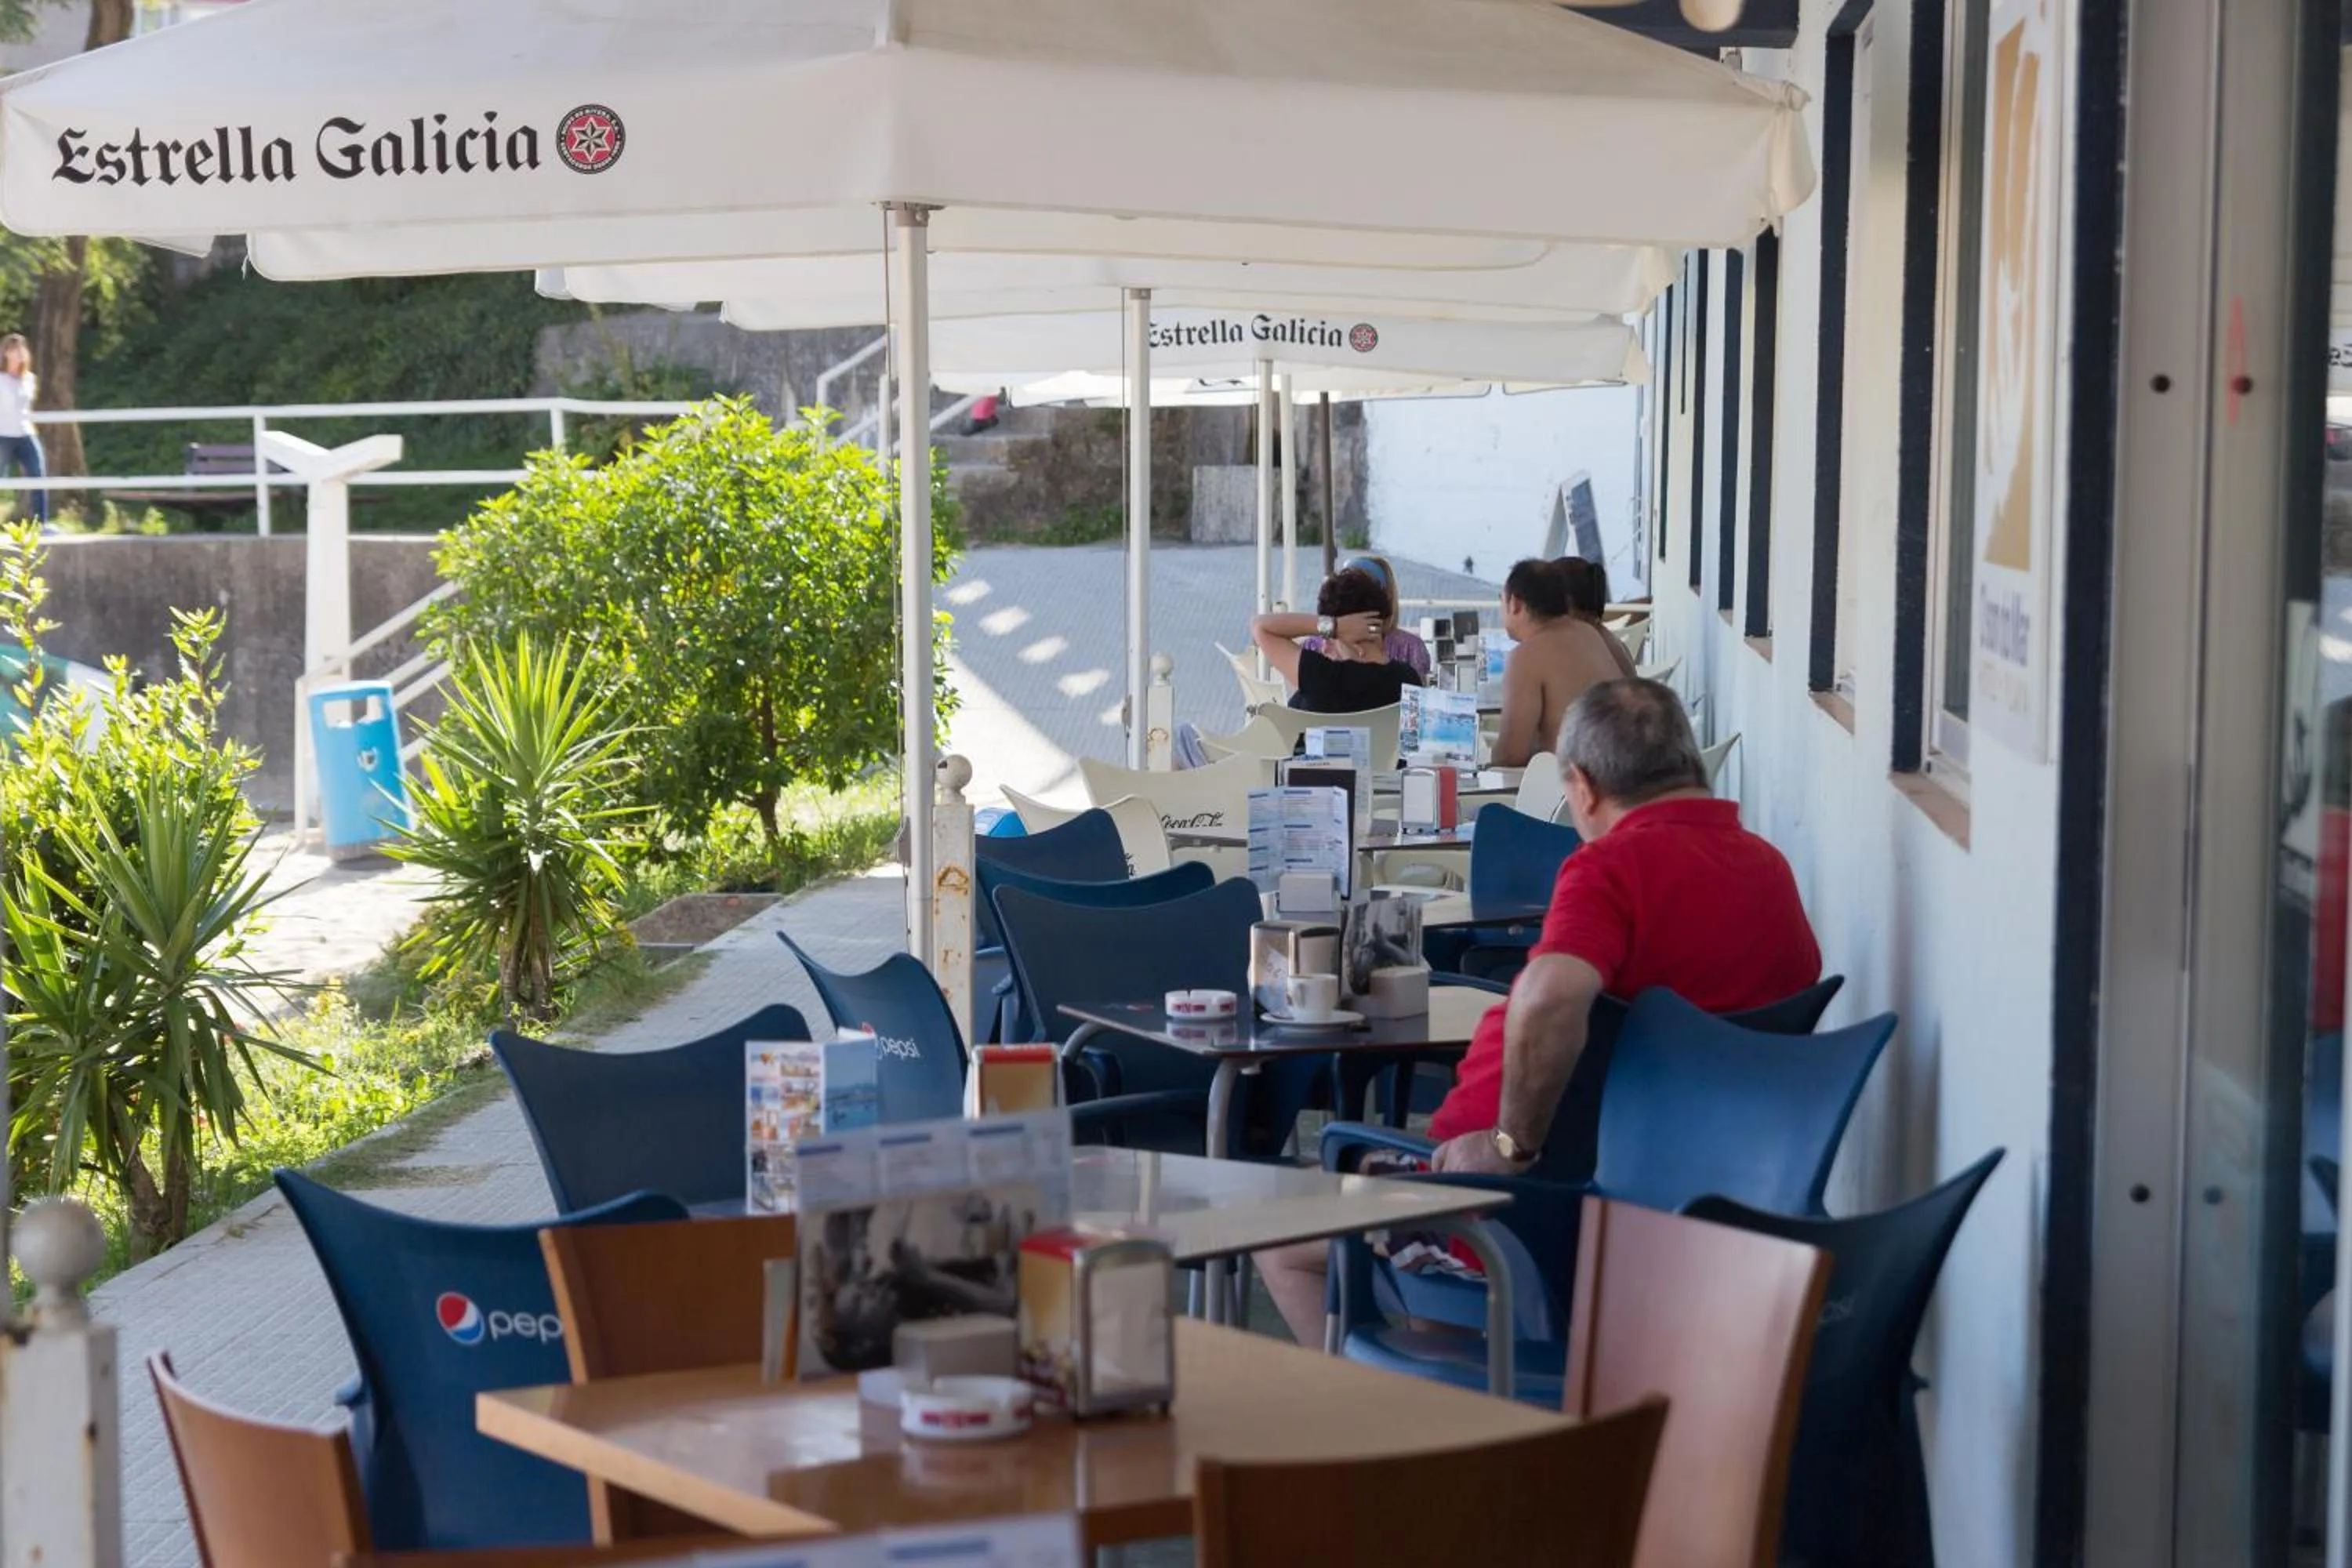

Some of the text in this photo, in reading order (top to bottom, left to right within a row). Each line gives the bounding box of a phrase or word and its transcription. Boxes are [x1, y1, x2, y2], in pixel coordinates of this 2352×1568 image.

[52, 125, 297, 187] Estrella
[315, 111, 542, 180] Galicia
[1250, 314, 1343, 347] Galicia
[880, 1036, 920, 1061] pepsi
[488, 1310, 564, 1345] pep
